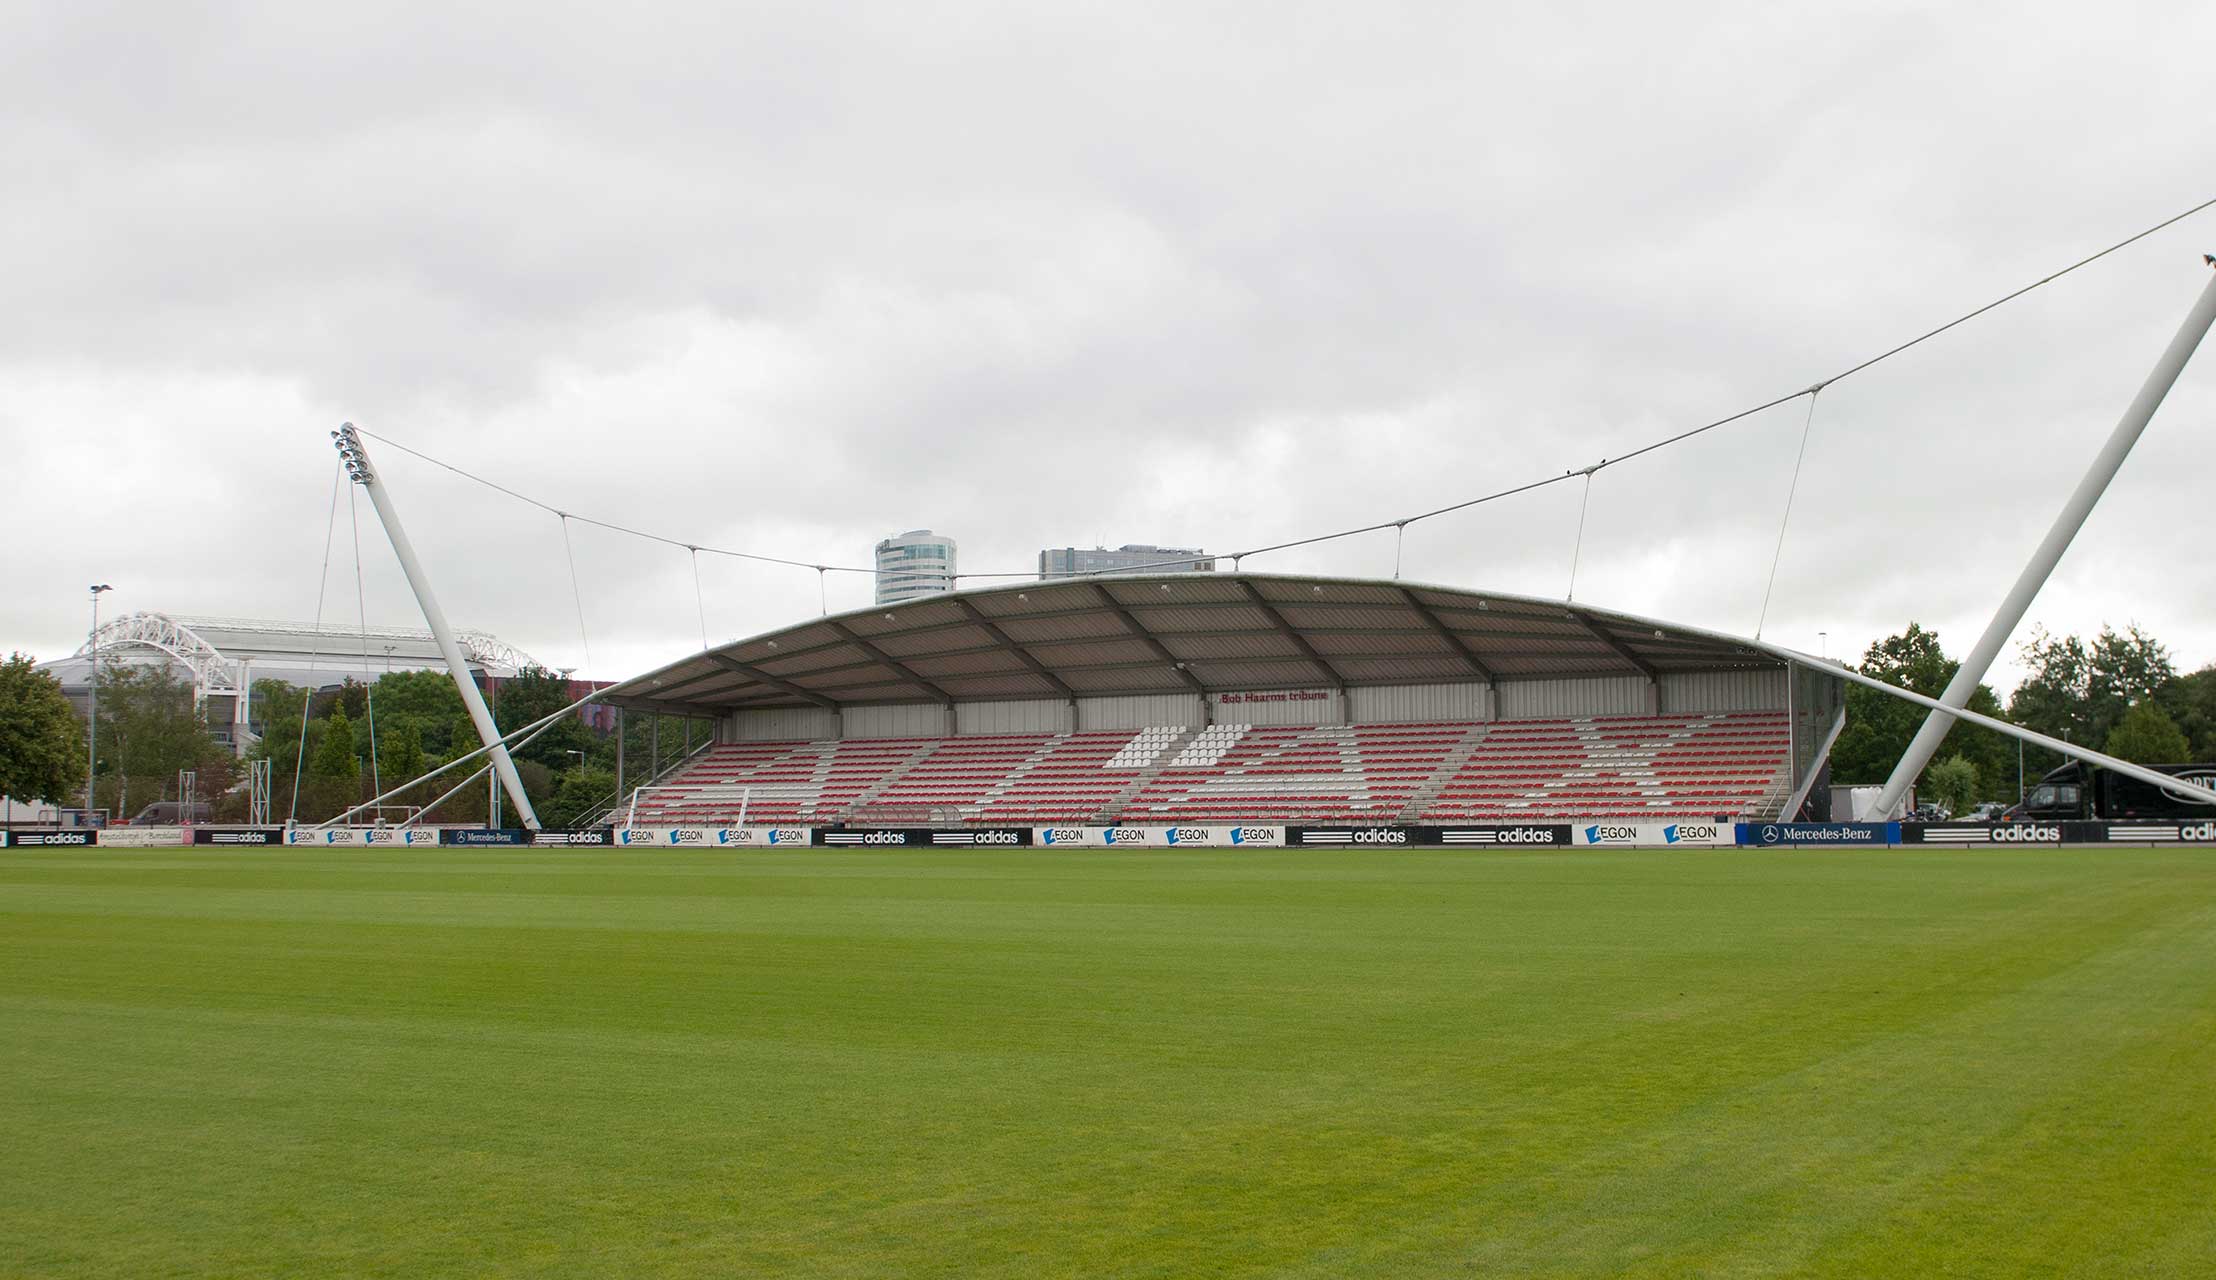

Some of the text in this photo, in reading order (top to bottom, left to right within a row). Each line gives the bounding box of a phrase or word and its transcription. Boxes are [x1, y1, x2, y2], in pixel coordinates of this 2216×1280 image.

[1221, 690, 1328, 703] Bob Haarms tribune
[239, 831, 266, 843] adidas
[467, 832, 512, 842] Mercedes-Benz
[569, 831, 603, 843] adidas
[864, 831, 905, 844] adidas
[975, 830, 1018, 844] adidas
[1354, 828, 1407, 843] adidas
[1498, 828, 1553, 843] adidas
[1783, 827, 1872, 840] Mercedes-Benz
[1992, 825, 2061, 841] adidas
[2181, 822, 2216, 840] adi
[44, 833, 86, 844] adidas
